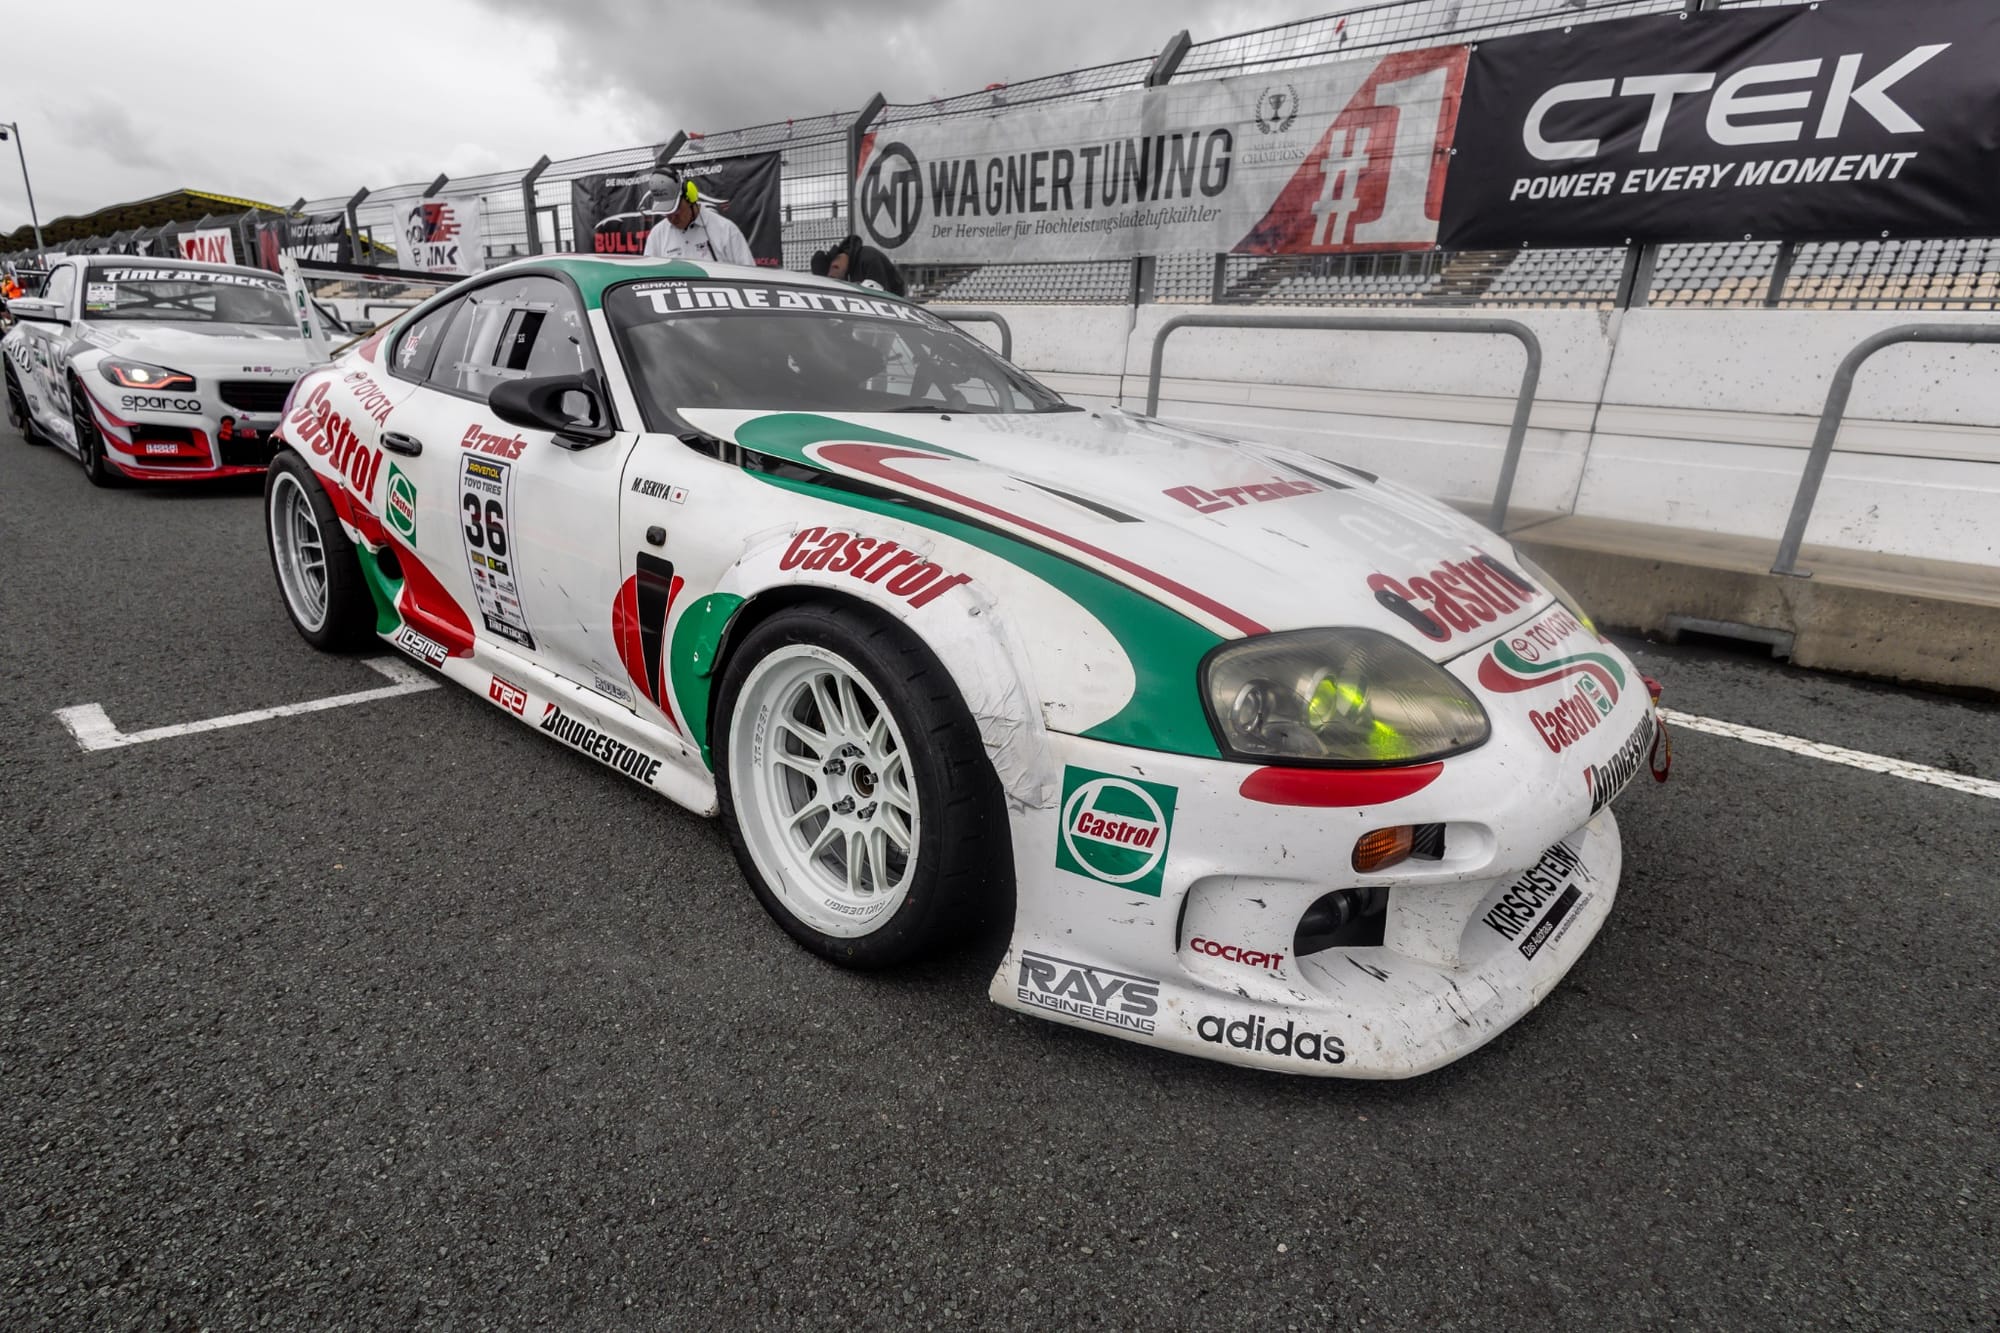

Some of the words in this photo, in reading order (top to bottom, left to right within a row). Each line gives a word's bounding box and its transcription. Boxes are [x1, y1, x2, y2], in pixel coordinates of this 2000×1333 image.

[1522, 43, 1952, 160] CTEK
[929, 128, 1233, 217] WAGNERTUNING
[1311, 67, 1448, 245] #1
[1510, 171, 1616, 201] POWER
[1621, 161, 1736, 194] EVERY
[1735, 151, 1917, 187] MOMENT
[594, 231, 652, 253] BULLT
[931, 223, 952, 239] Der
[955, 221, 1012, 239] Hersteller
[1014, 220, 1033, 241] für
[1034, 205, 1222, 236] Hochleistungsladeluftkühler
[103, 268, 171, 282] TIME
[172, 271, 267, 288] ATTACK
[631, 281, 688, 291] GERMAN
[635, 287, 769, 314] TIME
[775, 290, 923, 323] ATTACK
[121, 394, 202, 413] sparco
[353, 375, 395, 429] TOYOTA
[464, 476, 481, 490] TOYO
[481, 482, 503, 496] TIRES
[468, 462, 501, 479] RAVENOL
[390, 490, 414, 521] Castrol
[463, 492, 507, 557] 36
[779, 526, 974, 610] Castrol
[1525, 610, 1580, 651] TOYOTA
[1528, 684, 1602, 754] Castrol
[540, 702, 663, 785] BRIDGESTONE
[1077, 811, 1161, 849] Castrol
[1482, 840, 1583, 941] KIRSCHSTEIN
[1189, 937, 1284, 970] COCKPIT
[1521, 941, 1537, 957] Das
[1530, 920, 1555, 947] Autohaus
[1018, 955, 1161, 1017] RAYS
[1016, 987, 1157, 1033] ENGINEERING
[1196, 1014, 1346, 1064] adidas
